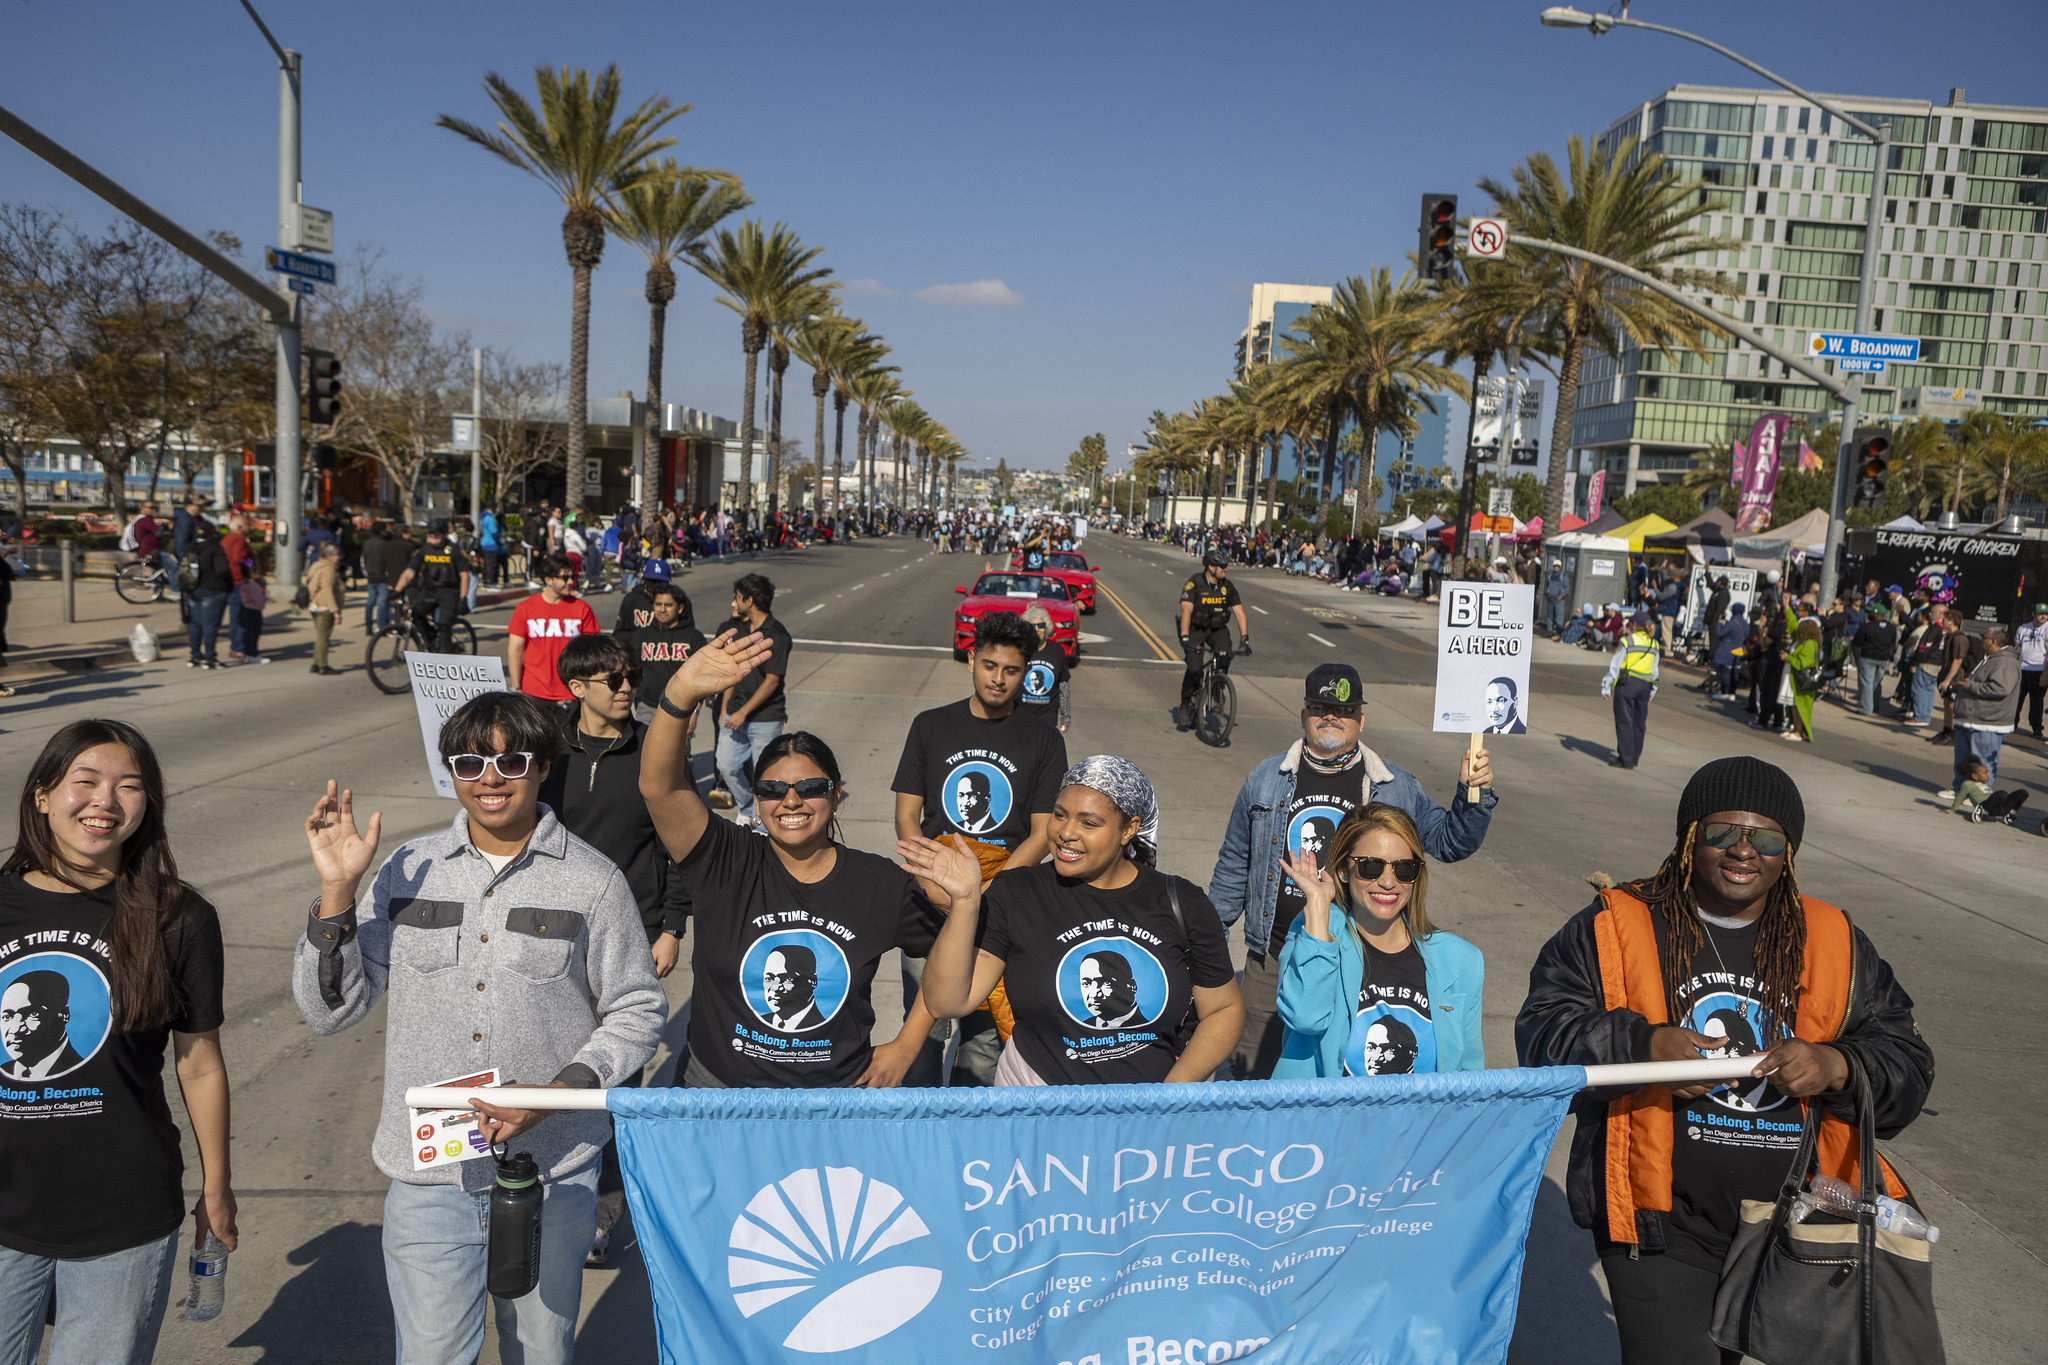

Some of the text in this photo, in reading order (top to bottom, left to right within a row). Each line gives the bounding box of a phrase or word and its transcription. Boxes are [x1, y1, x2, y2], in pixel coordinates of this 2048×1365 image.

[1829, 338, 1914, 357] W. BROADWAY
[1491, 502, 1509, 514] 25
[1889, 533, 1936, 551] REAPER
[1938, 536, 1969, 553] HOT
[1963, 539, 2020, 557] CHICKEN
[527, 619, 581, 638] NAK
[641, 642, 690, 661] NAK
[1448, 634, 1521, 656] A HERO
[419, 682, 459, 700] WHO
[946, 749, 1017, 773] THE TIME IS NOW
[1305, 794, 1329, 803] TIME
[1331, 796, 1341, 804] IS
[1342, 799, 1355, 810] NO
[778, 910, 809, 923] TIME
[811, 916, 825, 926] IS
[826, 921, 856, 942] NOW
[1056, 918, 1162, 946] THE TIME IS NOW
[0, 939, 20, 959] HE
[24, 930, 70, 945] TIME
[72, 931, 91, 946] IS
[1701, 972, 1736, 985] TIME
[1739, 975, 1755, 989] IS
[1398, 986, 1411, 999] IS
[1413, 991, 1430, 1010] NO
[735, 1023, 832, 1049] Be. Belong. Become.
[1062, 1032, 1158, 1048] Be. Belong. Become.
[745, 1041, 755, 1050] San
[755, 1044, 768, 1054] Diego
[769, 1049, 797, 1057] Community
[44, 1087, 104, 1099] Become.
[14, 1104, 53, 1112] Community
[53, 1102, 79, 1110] College
[80, 1099, 103, 1108] District
[1687, 1110, 1803, 1132] Be. Belong. Become.
[1702, 1127, 1714, 1136] San
[1714, 1129, 1732, 1138] Diego
[1732, 1131, 1766, 1141] Community
[1765, 1135, 1787, 1144] College
[962, 1143, 1324, 1211] SAN DIEGO
[966, 1198, 1171, 1263] Community
[1182, 1190, 1317, 1234] College
[970, 1305, 1013, 1325] City
[1021, 1275, 1092, 1311] College
[1114, 1254, 1163, 1282] Mesa
[1171, 1248, 1251, 1269] College
[1271, 1246, 1346, 1273] Mirama
[971, 1270, 1295, 1350] College of Continuing Education
